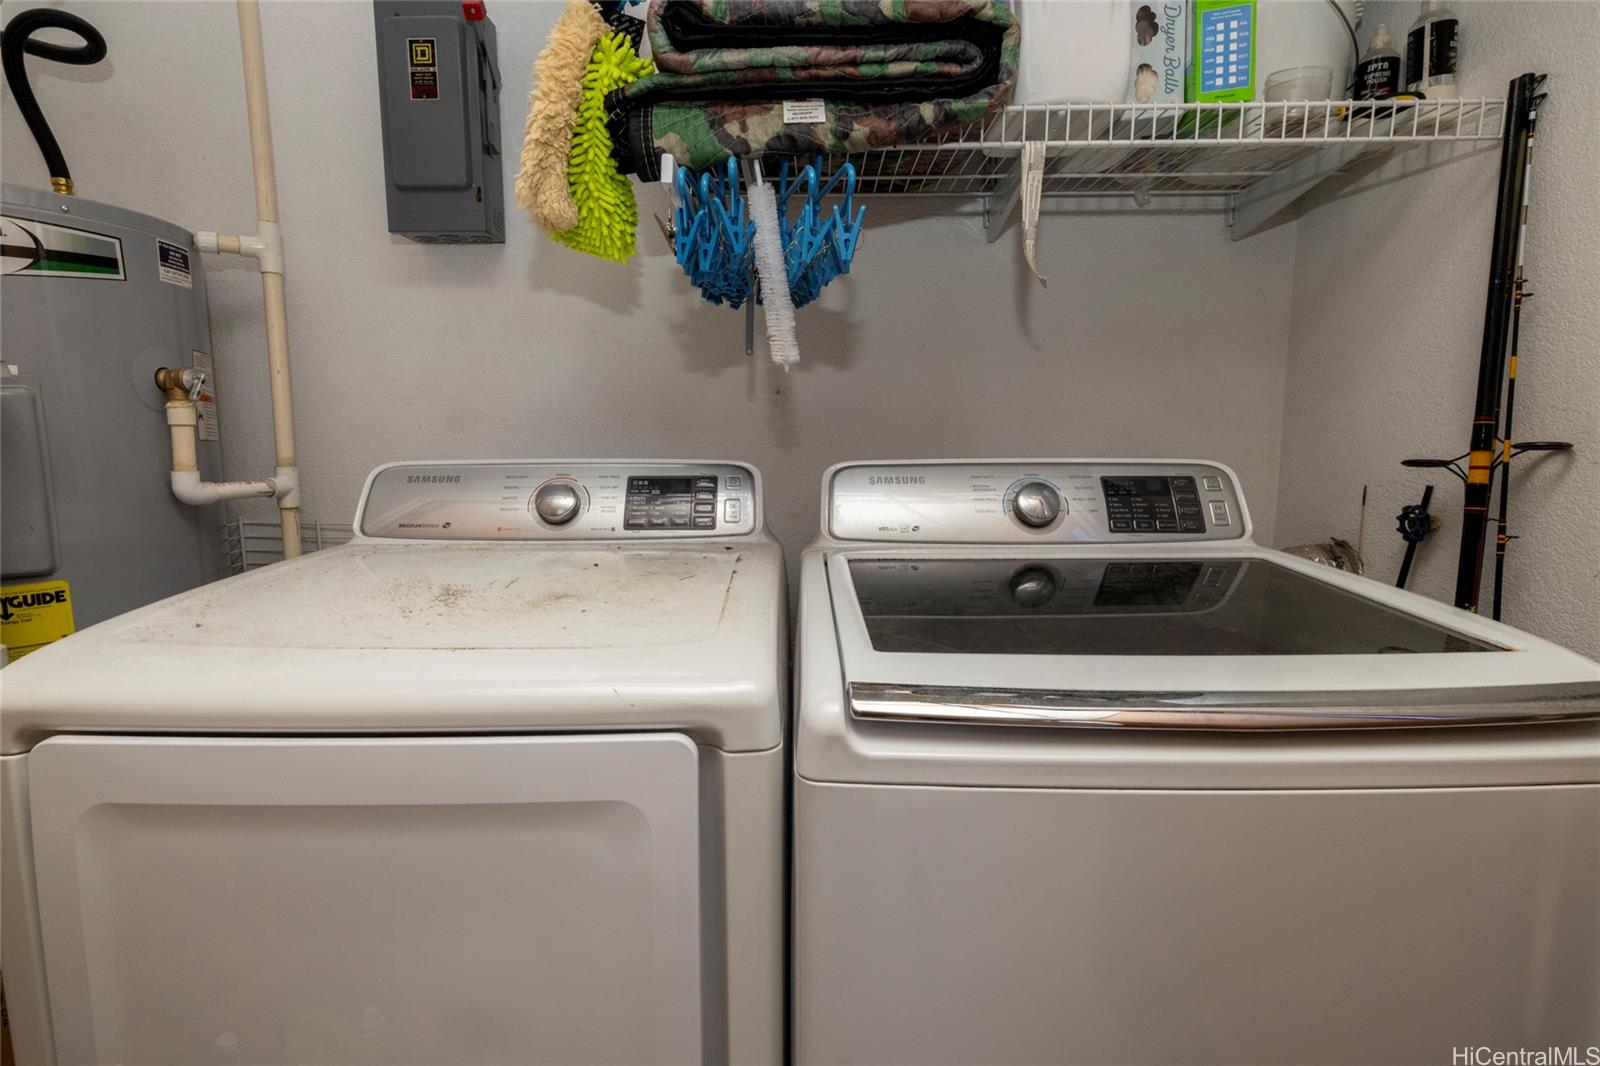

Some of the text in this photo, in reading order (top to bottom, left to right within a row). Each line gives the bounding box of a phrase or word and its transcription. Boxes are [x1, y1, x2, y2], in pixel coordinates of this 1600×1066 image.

[1160, 4, 1182, 94] Dryer Balls
[407, 475, 462, 484] SAMSUNG
[868, 476, 926, 485] SAMSUNG
